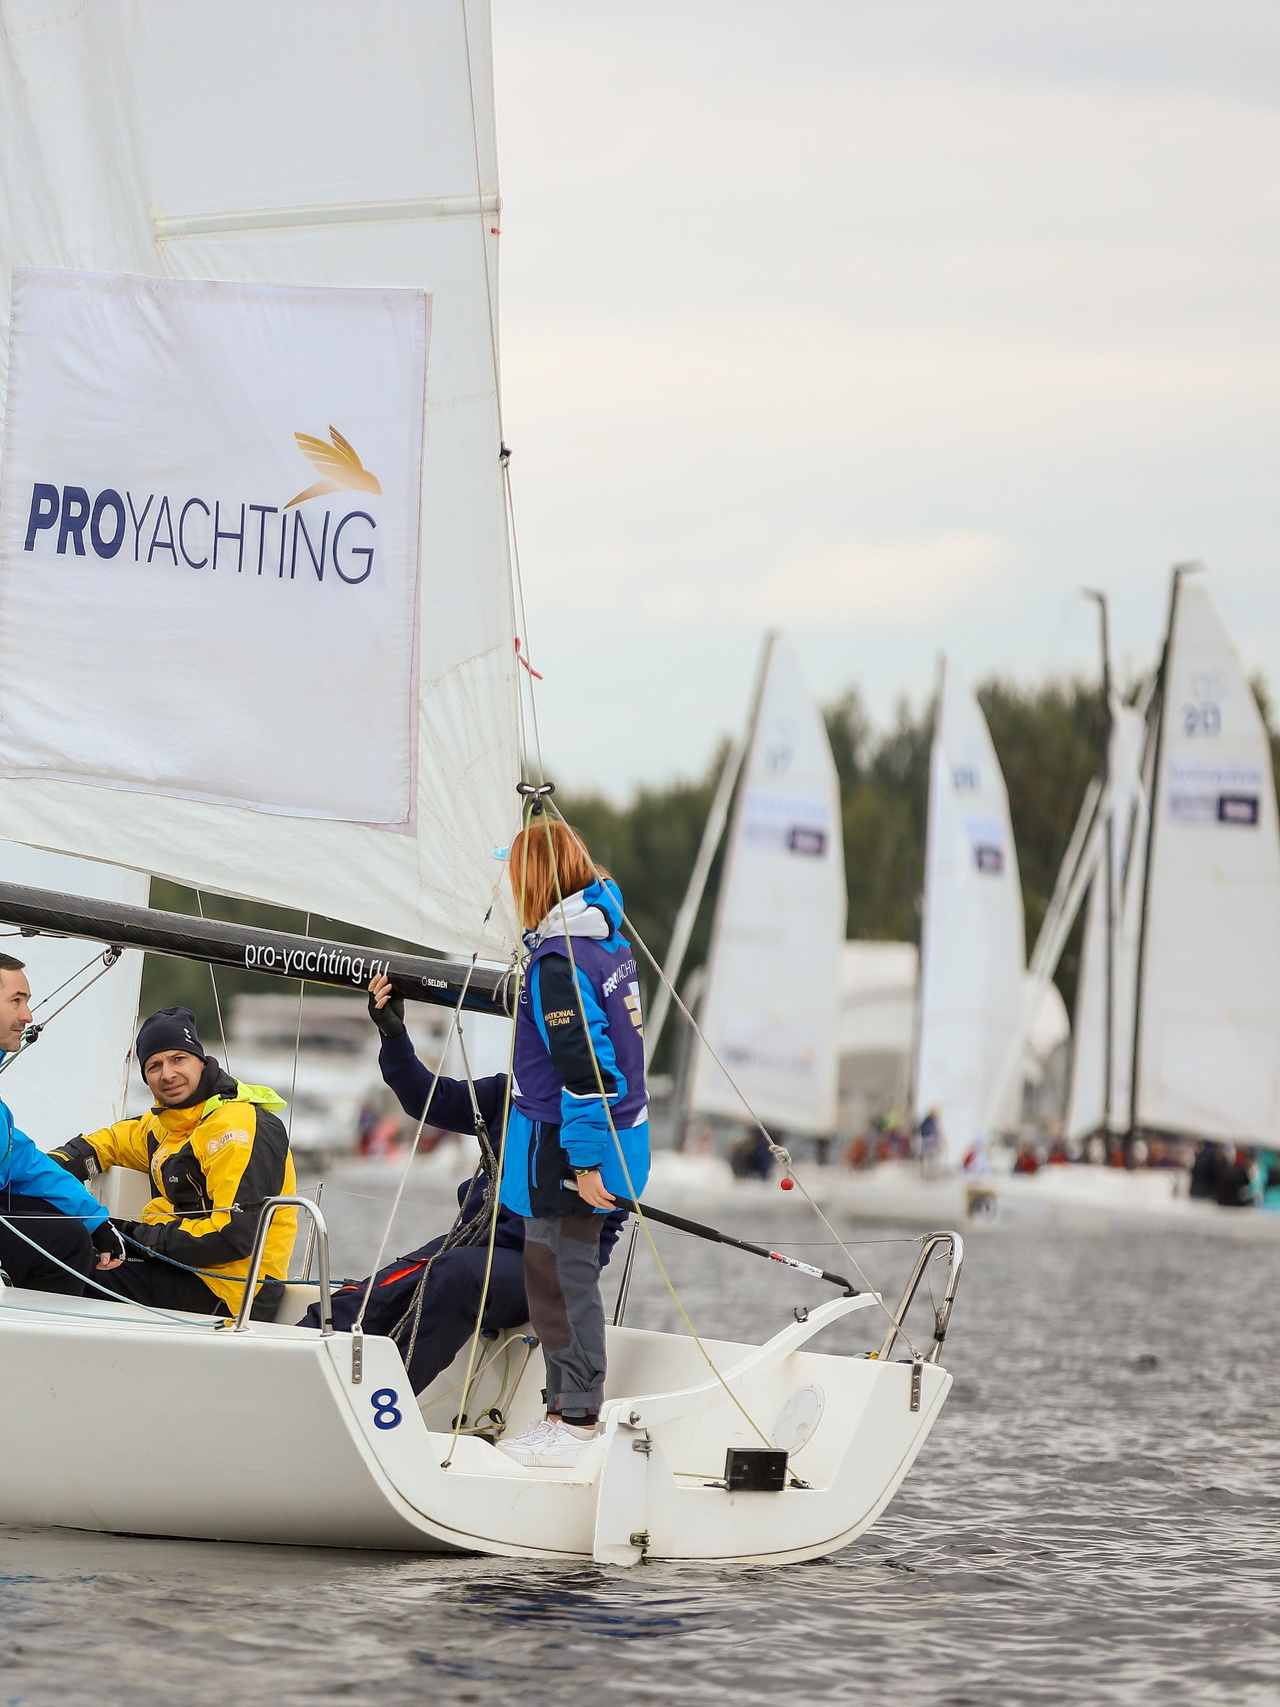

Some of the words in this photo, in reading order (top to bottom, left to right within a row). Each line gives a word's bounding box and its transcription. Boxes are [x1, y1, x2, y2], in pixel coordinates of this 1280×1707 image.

[23, 482, 378, 585] PROYACHTING
[245, 943, 390, 984] pro-yachting.ru
[545, 1009, 575, 1021] NATIONAL
[549, 1017, 570, 1026] TEAM
[370, 1387, 403, 1431] 8
